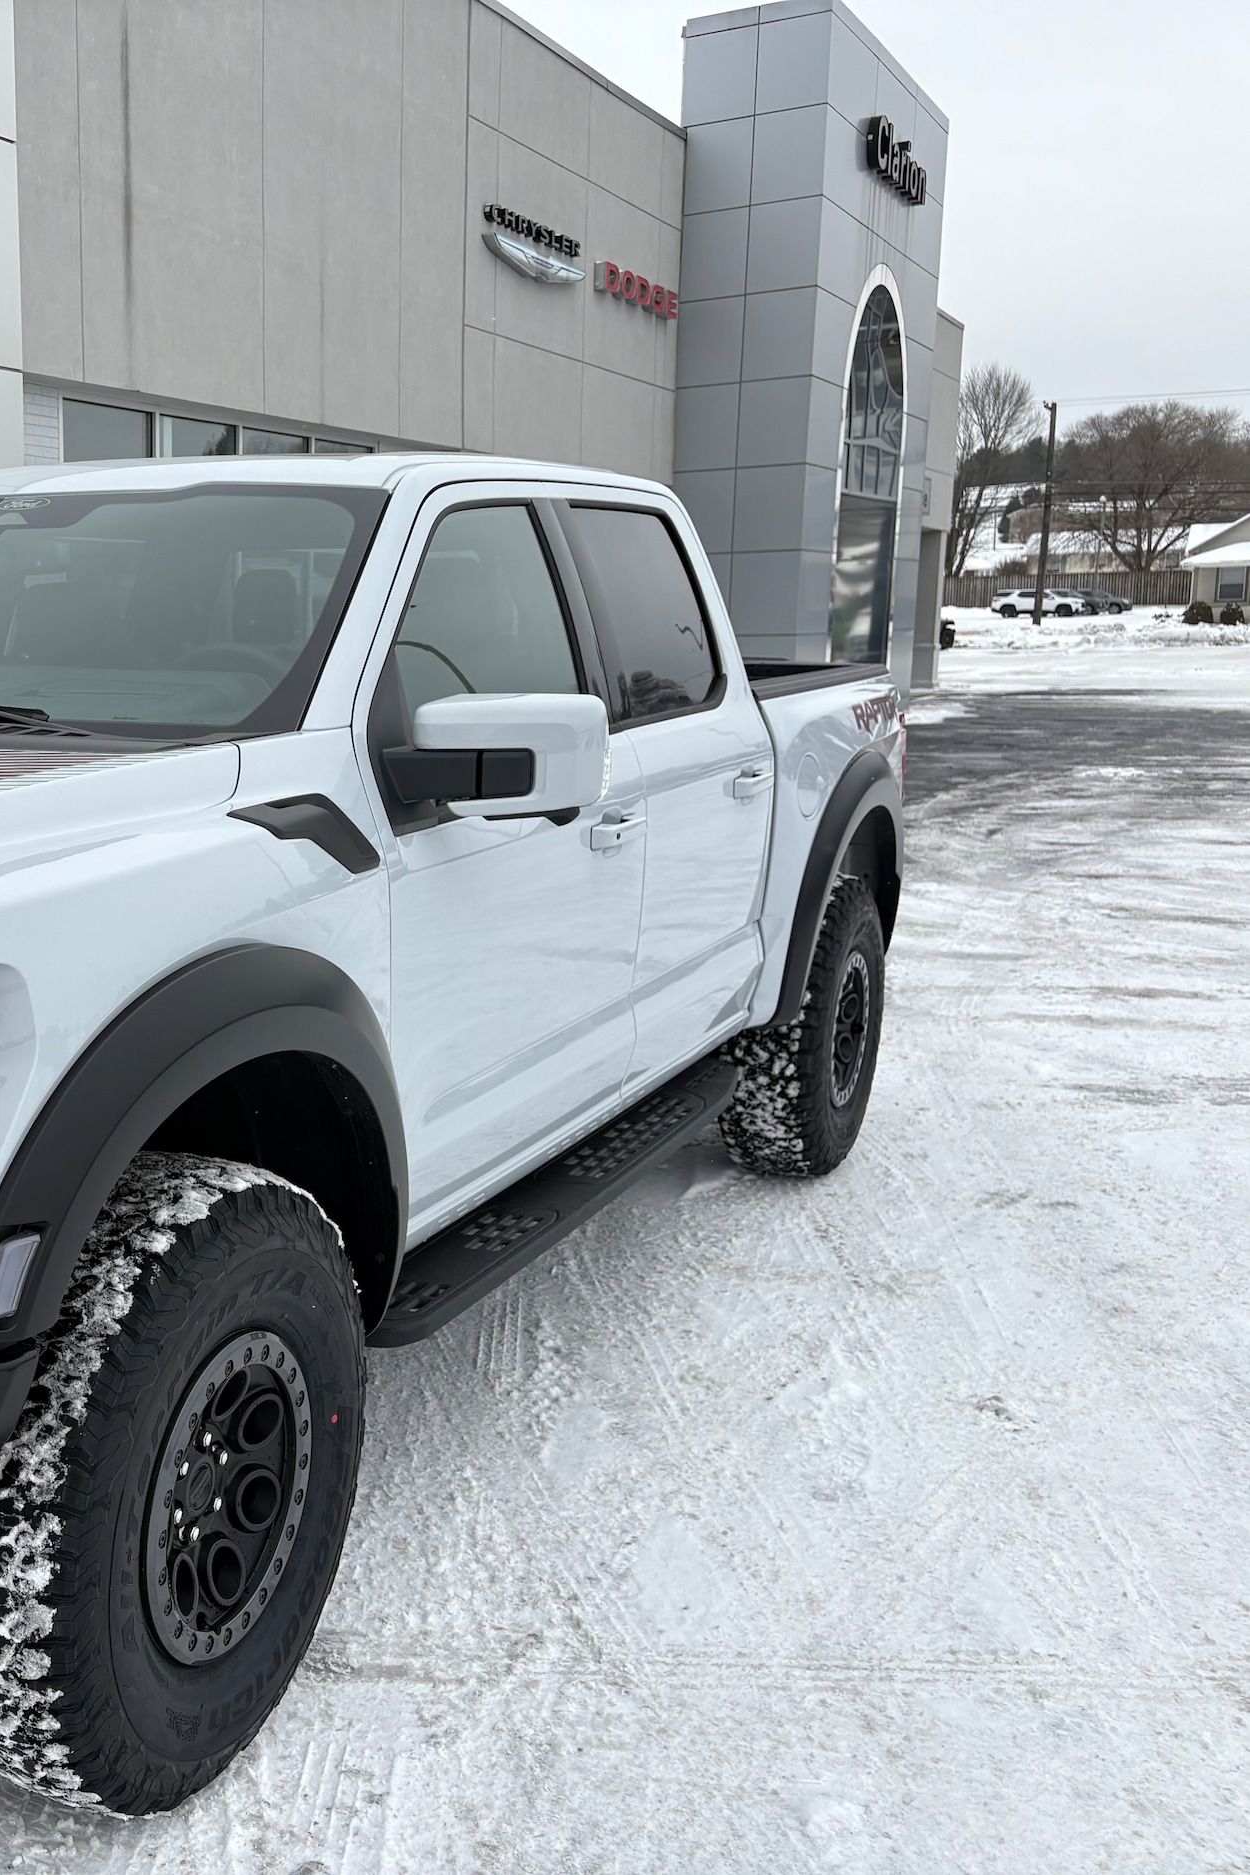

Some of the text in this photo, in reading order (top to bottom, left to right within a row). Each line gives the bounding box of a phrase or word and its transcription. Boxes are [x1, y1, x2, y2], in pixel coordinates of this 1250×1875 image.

[867, 114, 927, 206] Clarion
[484, 203, 581, 257] CHRYSLER
[596, 261, 678, 319] DODGE
[1, 498, 43, 510] Ford
[851, 695, 897, 736] RAPTO
[250, 1266, 307, 1297] T/A
